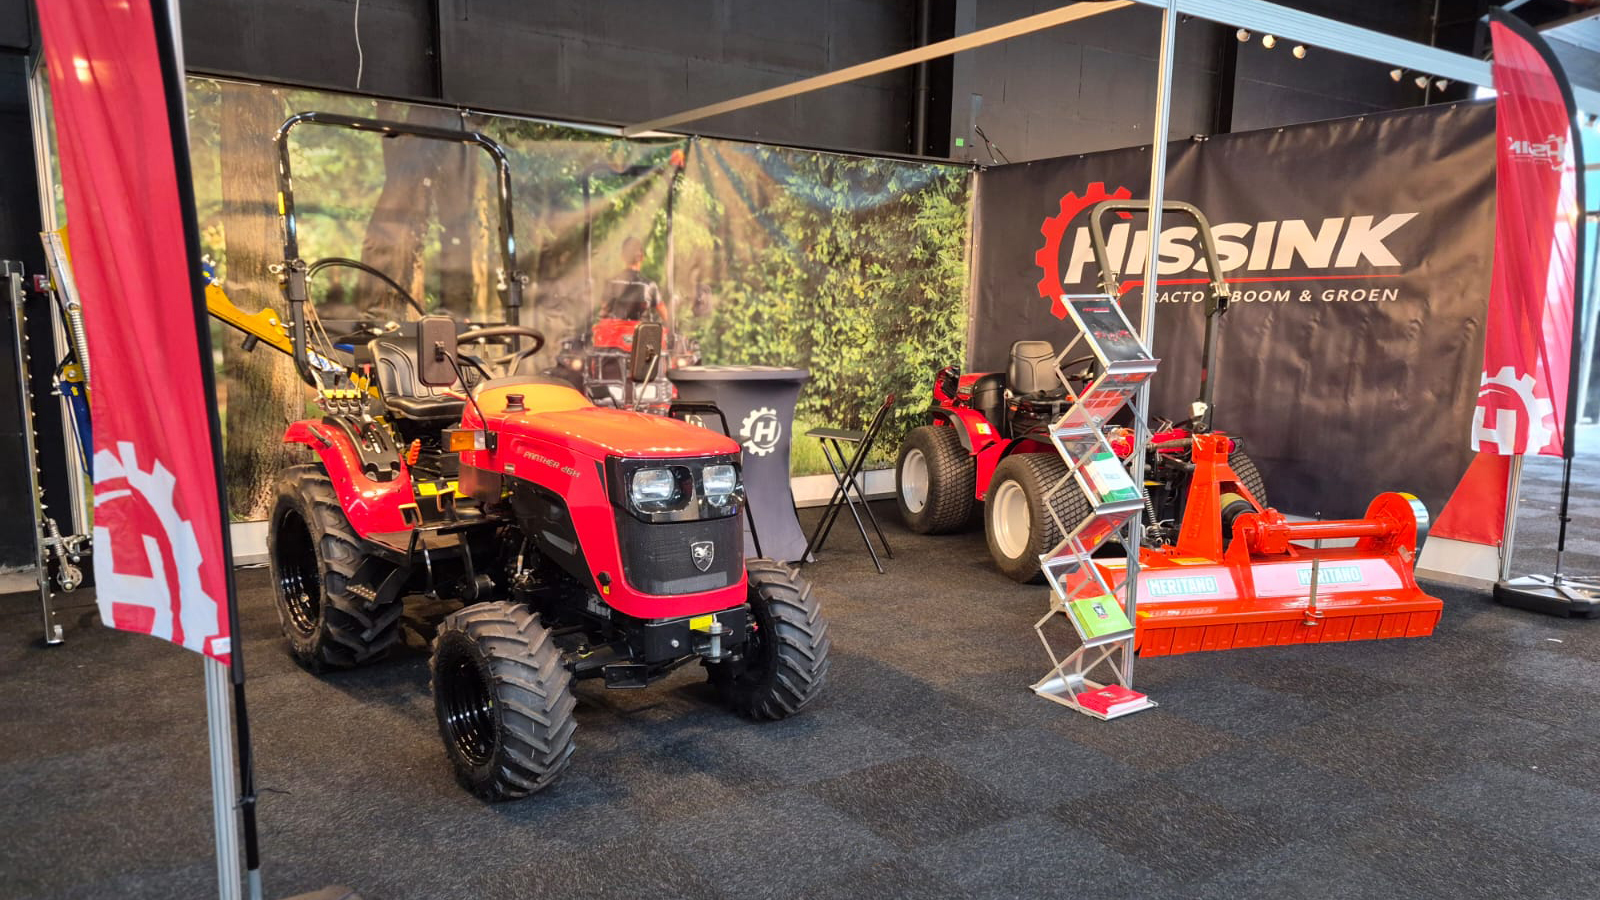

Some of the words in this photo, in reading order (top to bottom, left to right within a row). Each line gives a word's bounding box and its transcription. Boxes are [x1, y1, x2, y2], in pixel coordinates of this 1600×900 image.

[1063, 212, 1420, 284] HISSINK
[1231, 290, 1291, 302] BOOM
[1299, 289, 1312, 302] &
[1322, 288, 1399, 302] GROEN
[754, 420, 777, 442] H
[1471, 405, 1517, 455] H
[1299, 567, 1361, 585] MRITANO
[1149, 578, 1216, 595] MERITANO
